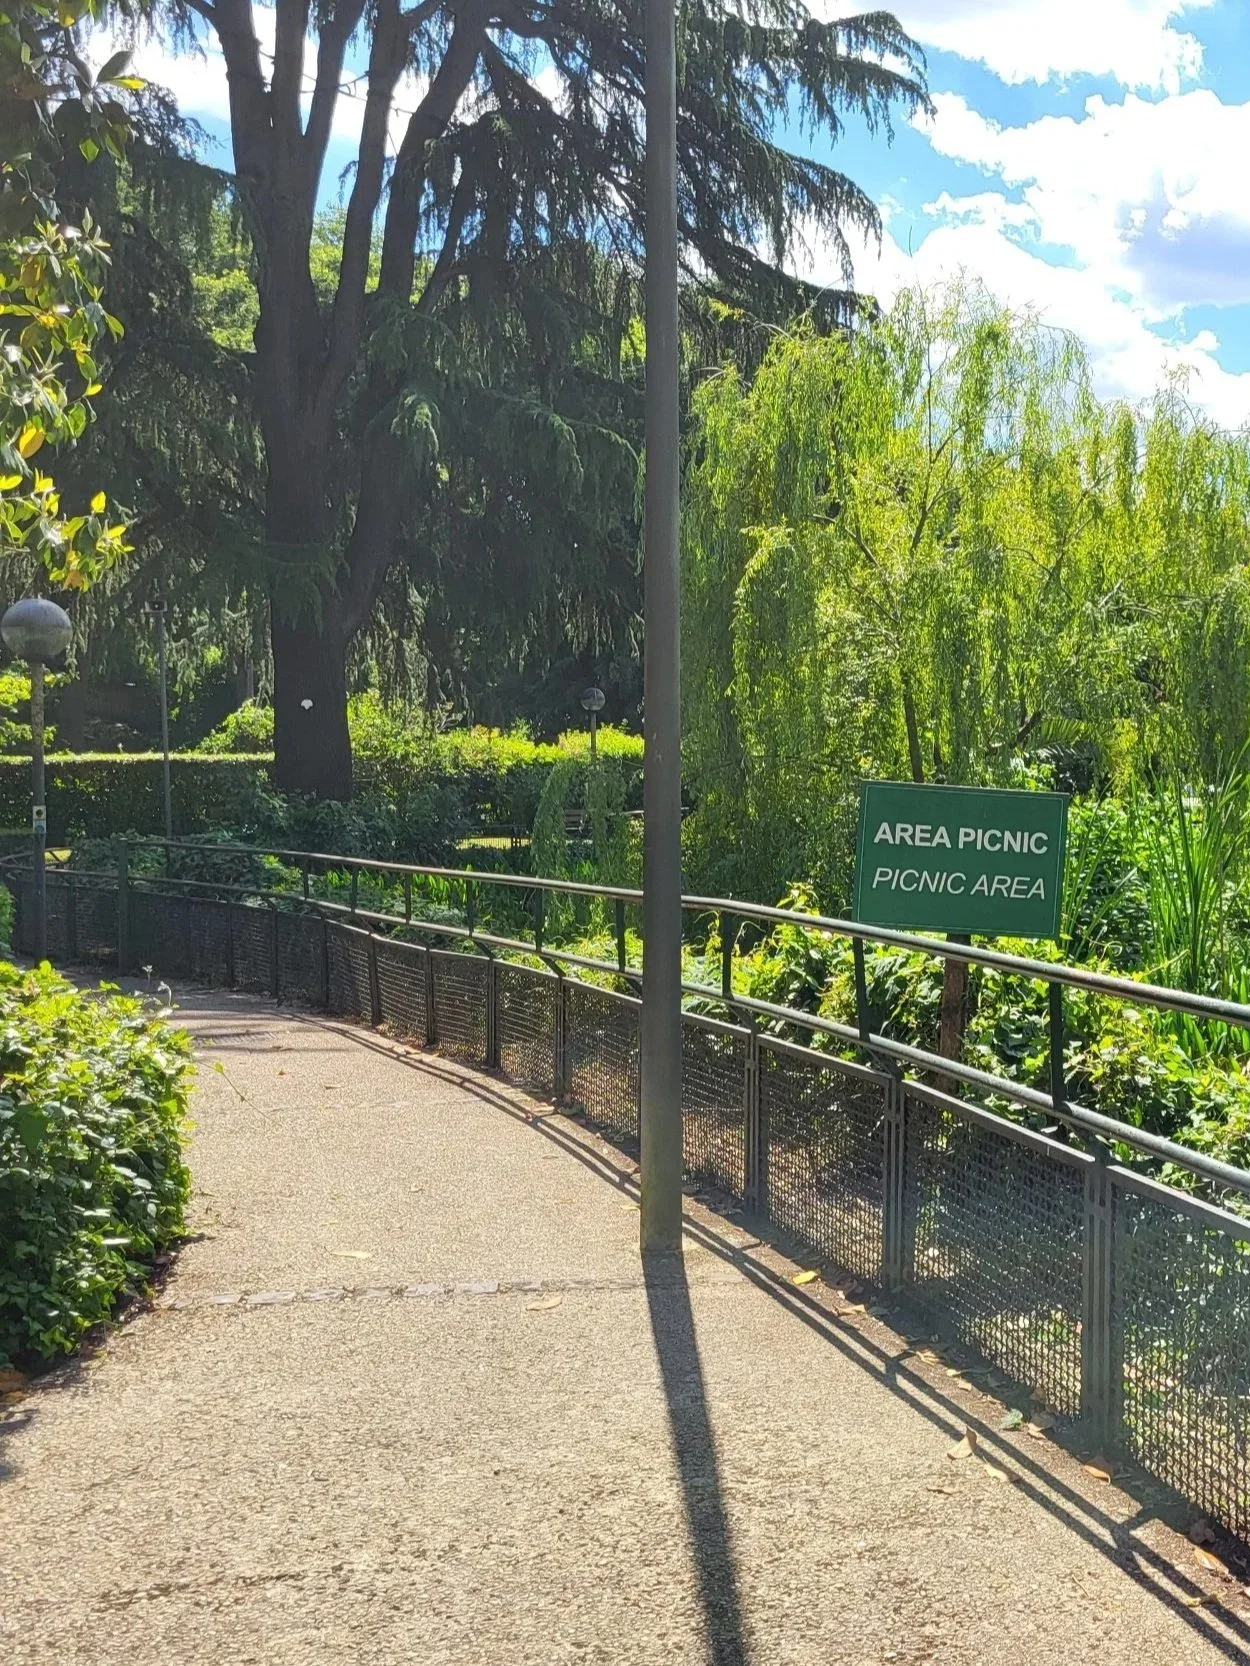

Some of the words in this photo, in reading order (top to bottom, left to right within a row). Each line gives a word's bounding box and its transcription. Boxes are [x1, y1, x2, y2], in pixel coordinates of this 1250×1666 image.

[873, 822, 952, 849] AREA
[958, 827, 1049, 854] PICNIC
[872, 867, 967, 895] PICNIC
[970, 874, 1045, 900] AREA
